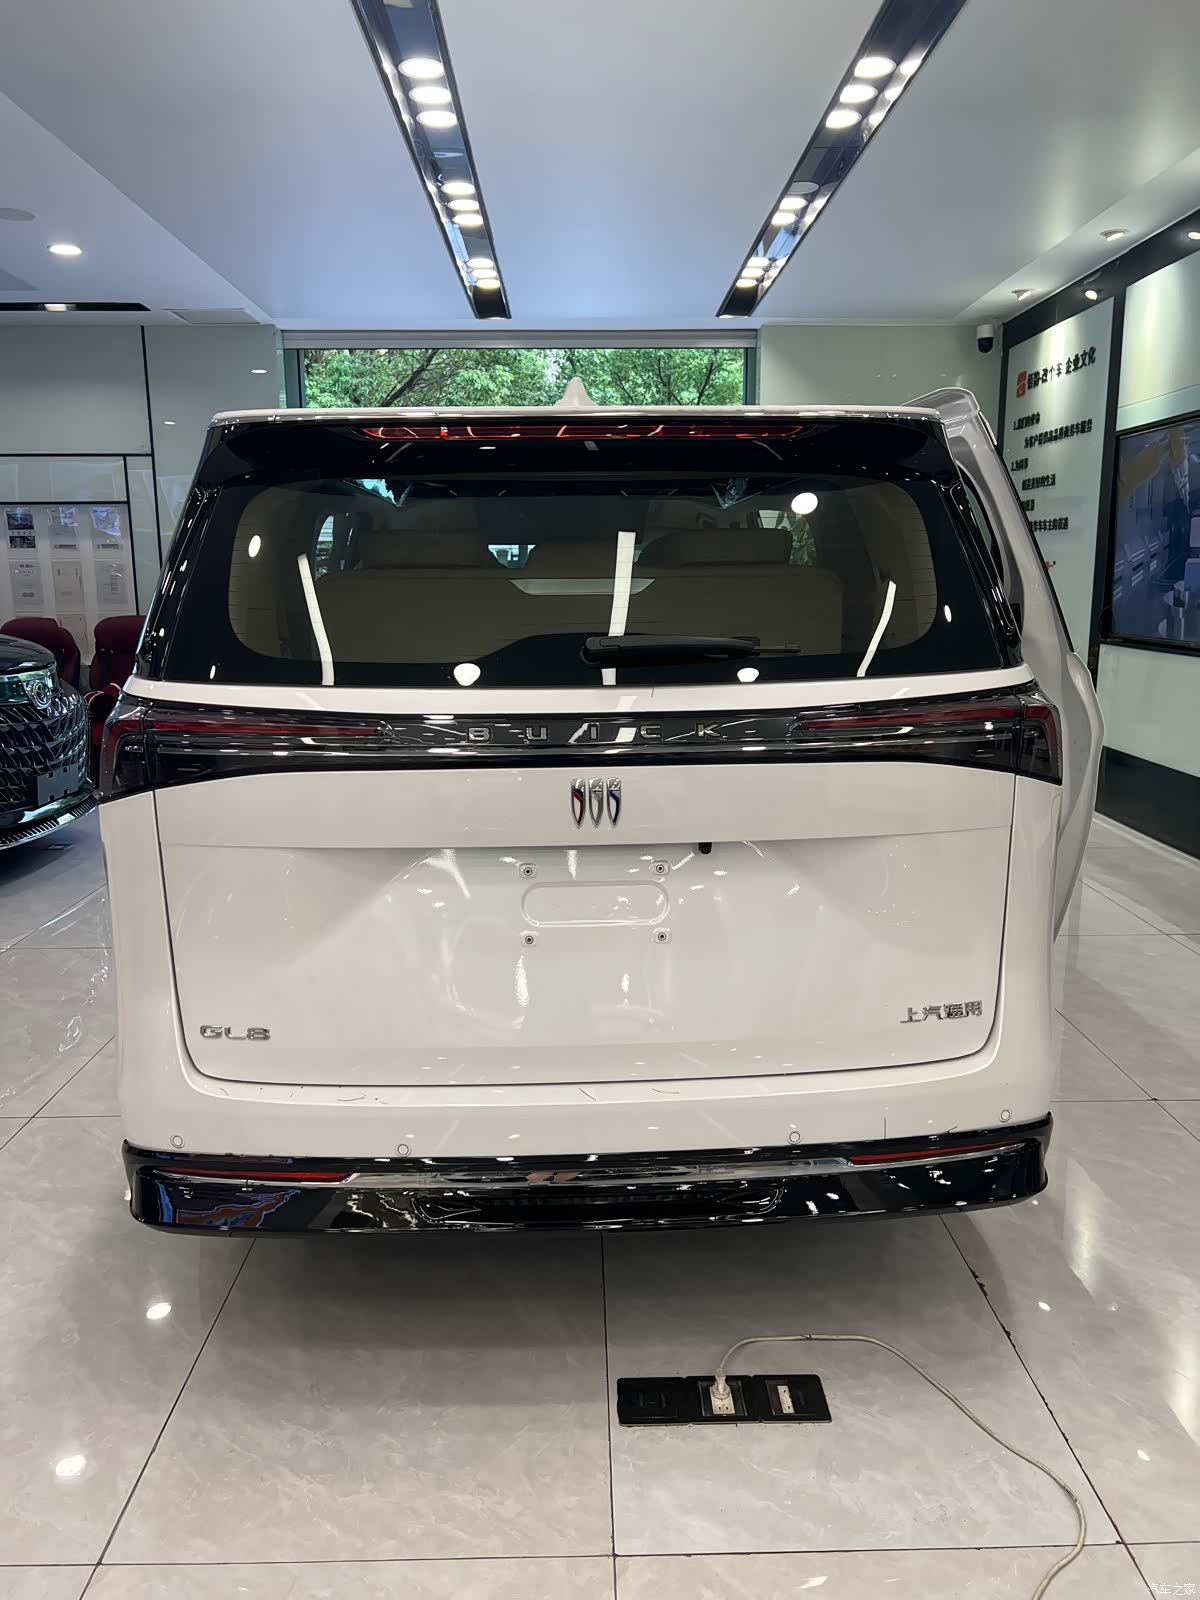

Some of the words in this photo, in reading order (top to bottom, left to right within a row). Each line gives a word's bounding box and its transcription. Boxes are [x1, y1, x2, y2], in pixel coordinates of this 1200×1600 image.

[1065, 346, 1096, 374] 企业文化
[467, 722, 721, 741] BUICK
[900, 1000, 983, 1023] 上汽通用
[199, 1025, 271, 1041] GL8
